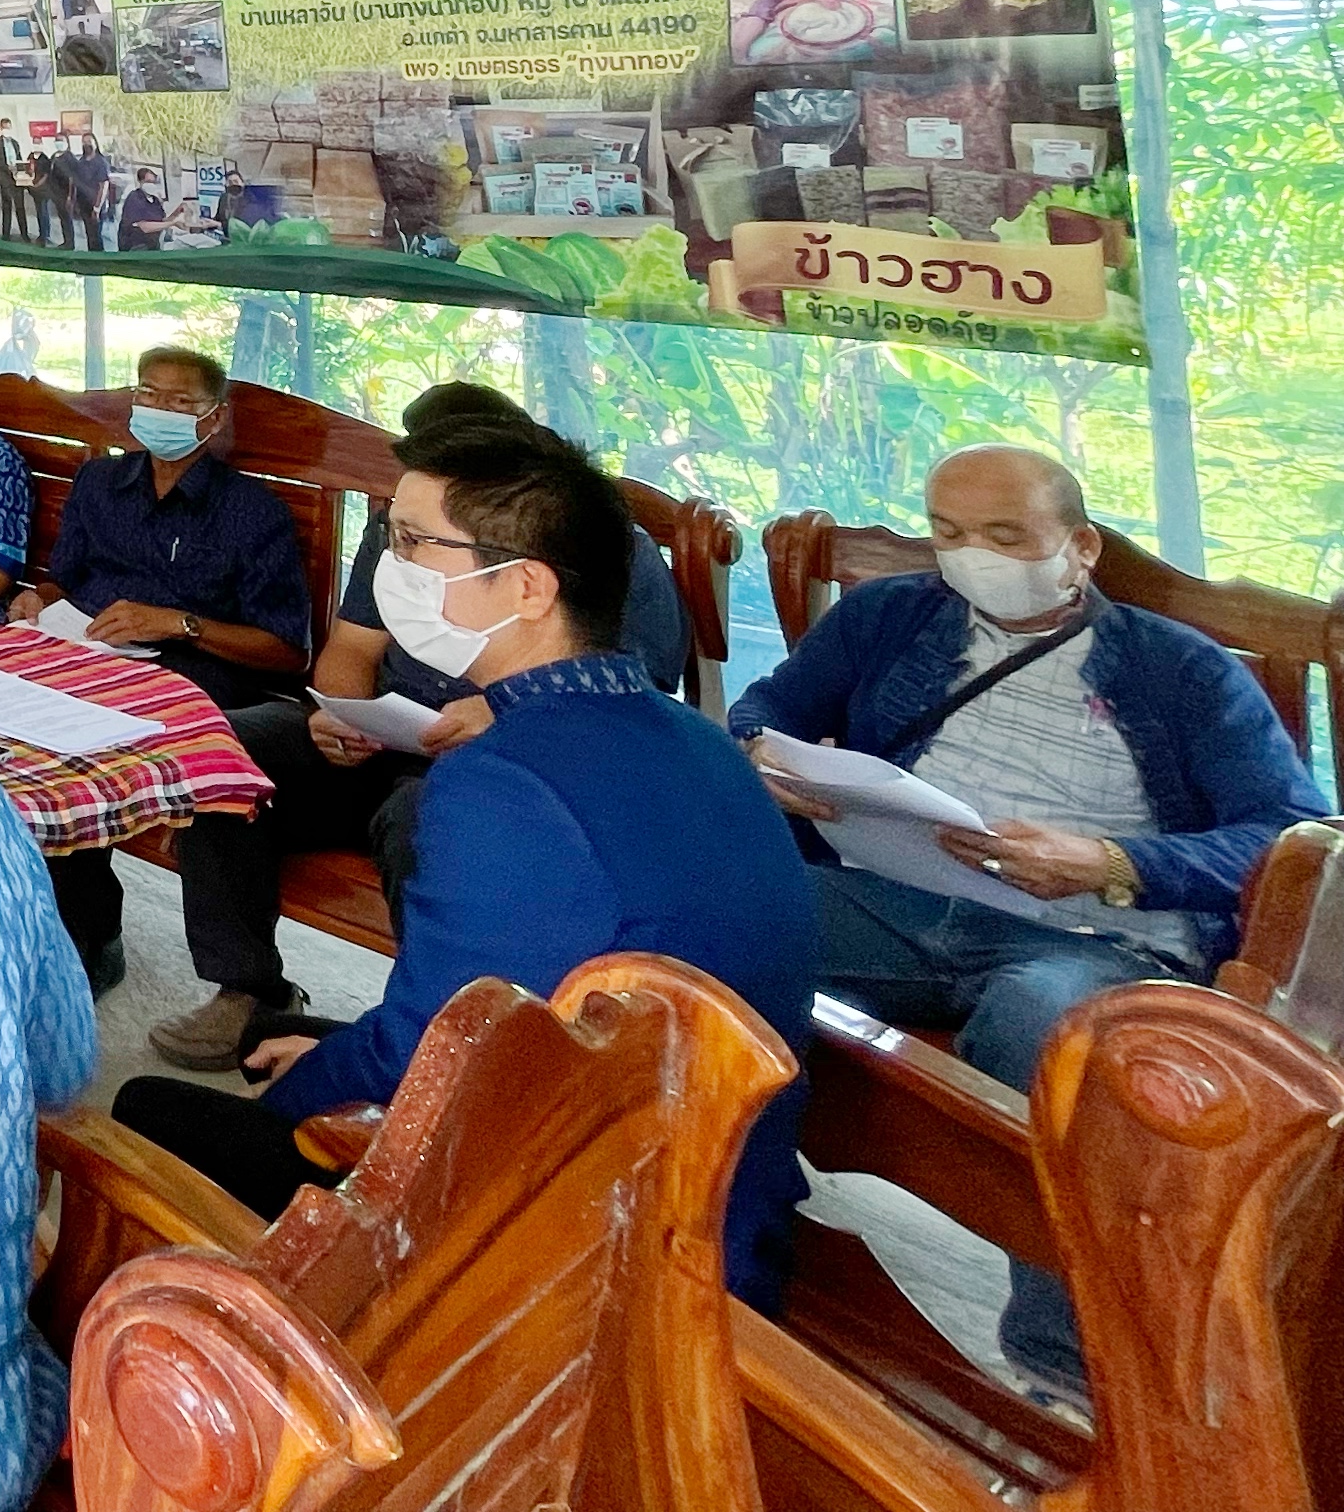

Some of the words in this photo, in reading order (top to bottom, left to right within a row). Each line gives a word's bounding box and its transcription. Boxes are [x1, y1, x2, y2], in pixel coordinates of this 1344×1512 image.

[476, 21, 612, 44] จ.มหาสารคาม
[619, 14, 697, 37] 44190
[404, 62, 439, 78] เพจ
[458, 57, 560, 80] เกษตรภูธร
[794, 232, 1053, 306] ข้าวฮาง
